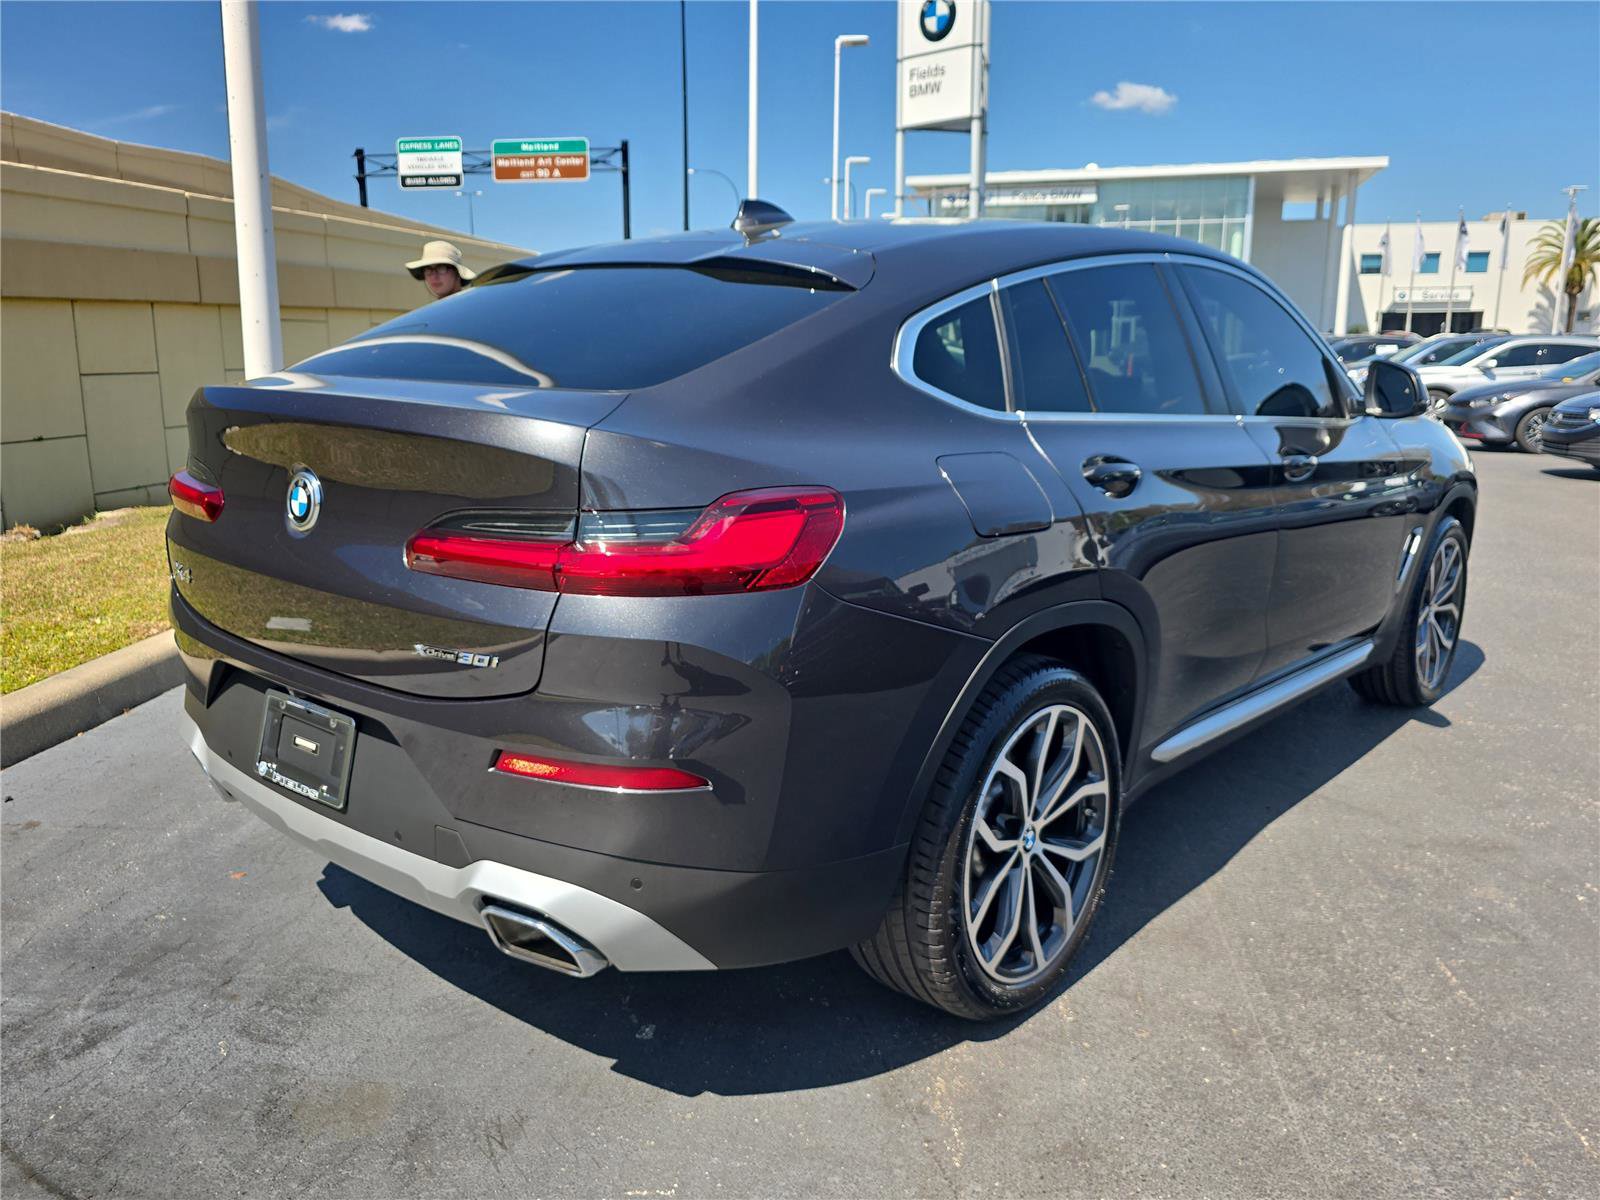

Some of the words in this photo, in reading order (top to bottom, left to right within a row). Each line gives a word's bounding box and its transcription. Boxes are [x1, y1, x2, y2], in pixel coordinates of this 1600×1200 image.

[909, 63, 946, 80] Fields
[909, 80, 942, 98] BMW
[400, 142, 432, 151] EXPRESS
[434, 141, 459, 150] LANES
[521, 142, 560, 151] Maitland
[496, 158, 535, 167] Maitland
[537, 157, 552, 166] Art
[554, 157, 584, 166] Center
[427, 176, 457, 185] ALLOWED
